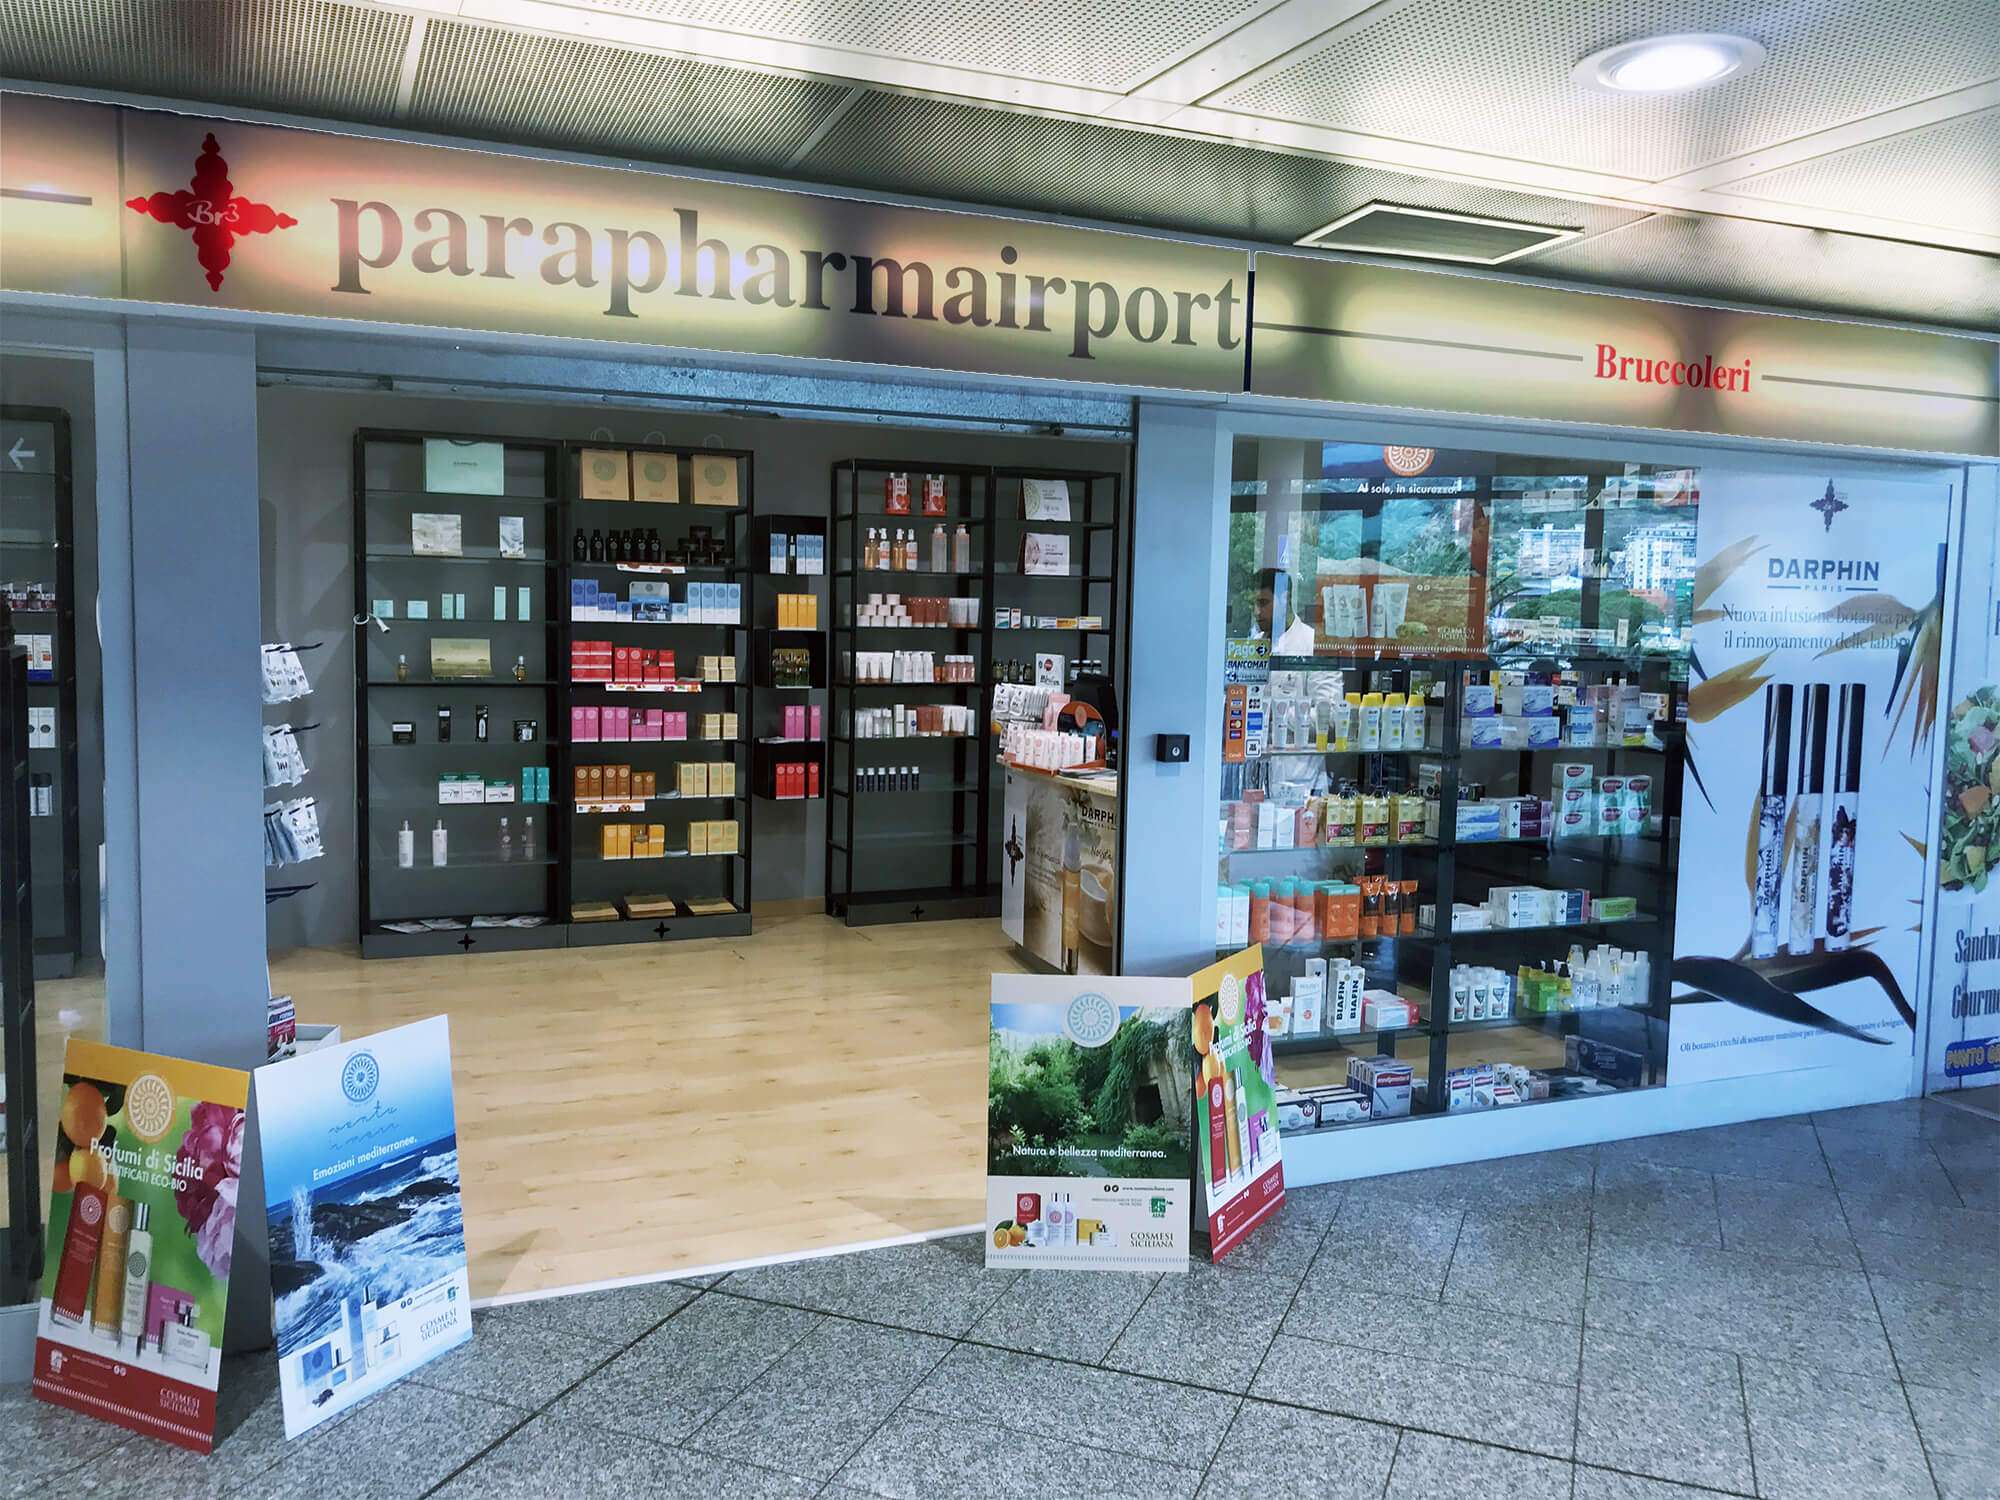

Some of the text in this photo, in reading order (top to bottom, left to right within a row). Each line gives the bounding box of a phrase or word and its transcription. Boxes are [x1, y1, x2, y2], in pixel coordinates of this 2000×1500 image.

[186, 200, 240, 226] Br3
[330, 198, 1242, 360] parapharmairport
[1595, 344, 1751, 392] Bruccoleri
[1357, 483, 1369, 493] Al
[1371, 485, 1394, 494] sole,
[1396, 484, 1406, 493] in
[1768, 558, 1880, 581] DARPHIN
[1721, 603, 1767, 623] Nuova
[1770, 605, 1834, 624] infusione
[1836, 609, 1893, 625] botanica
[1228, 641, 1256, 660] Pago
[1724, 631, 1733, 648] il
[1735, 631, 1832, 650] rinnovamento
[1835, 632, 1868, 649] delle
[1227, 660, 1268, 669] BANCOMAT
[1800, 847, 1809, 903] DARPHIN
[1336, 981, 1346, 1021] BIAFIN
[1350, 980, 1359, 1019] BIAFIN
[1680, 1042, 1691, 1052] Oli
[1692, 1040, 1720, 1050] botanici
[90, 1136, 204, 1180] Profumi di Sicilia
[1012, 1144, 1167, 1159] Natura e bellezza mediterranea.
[312, 1154, 356, 1181] Emozioni
[150, 1174, 187, 1192] ECO-BIO
[1129, 1240, 1174, 1249] SICILIANA
[1130, 1232, 1174, 1241] COSMESI
[420, 1307, 457, 1333] COSMESI
[421, 1317, 459, 1341] SICILIANA
[159, 1388, 201, 1408] COSMESI
[159, 1396, 200, 1418] SICILIANA
